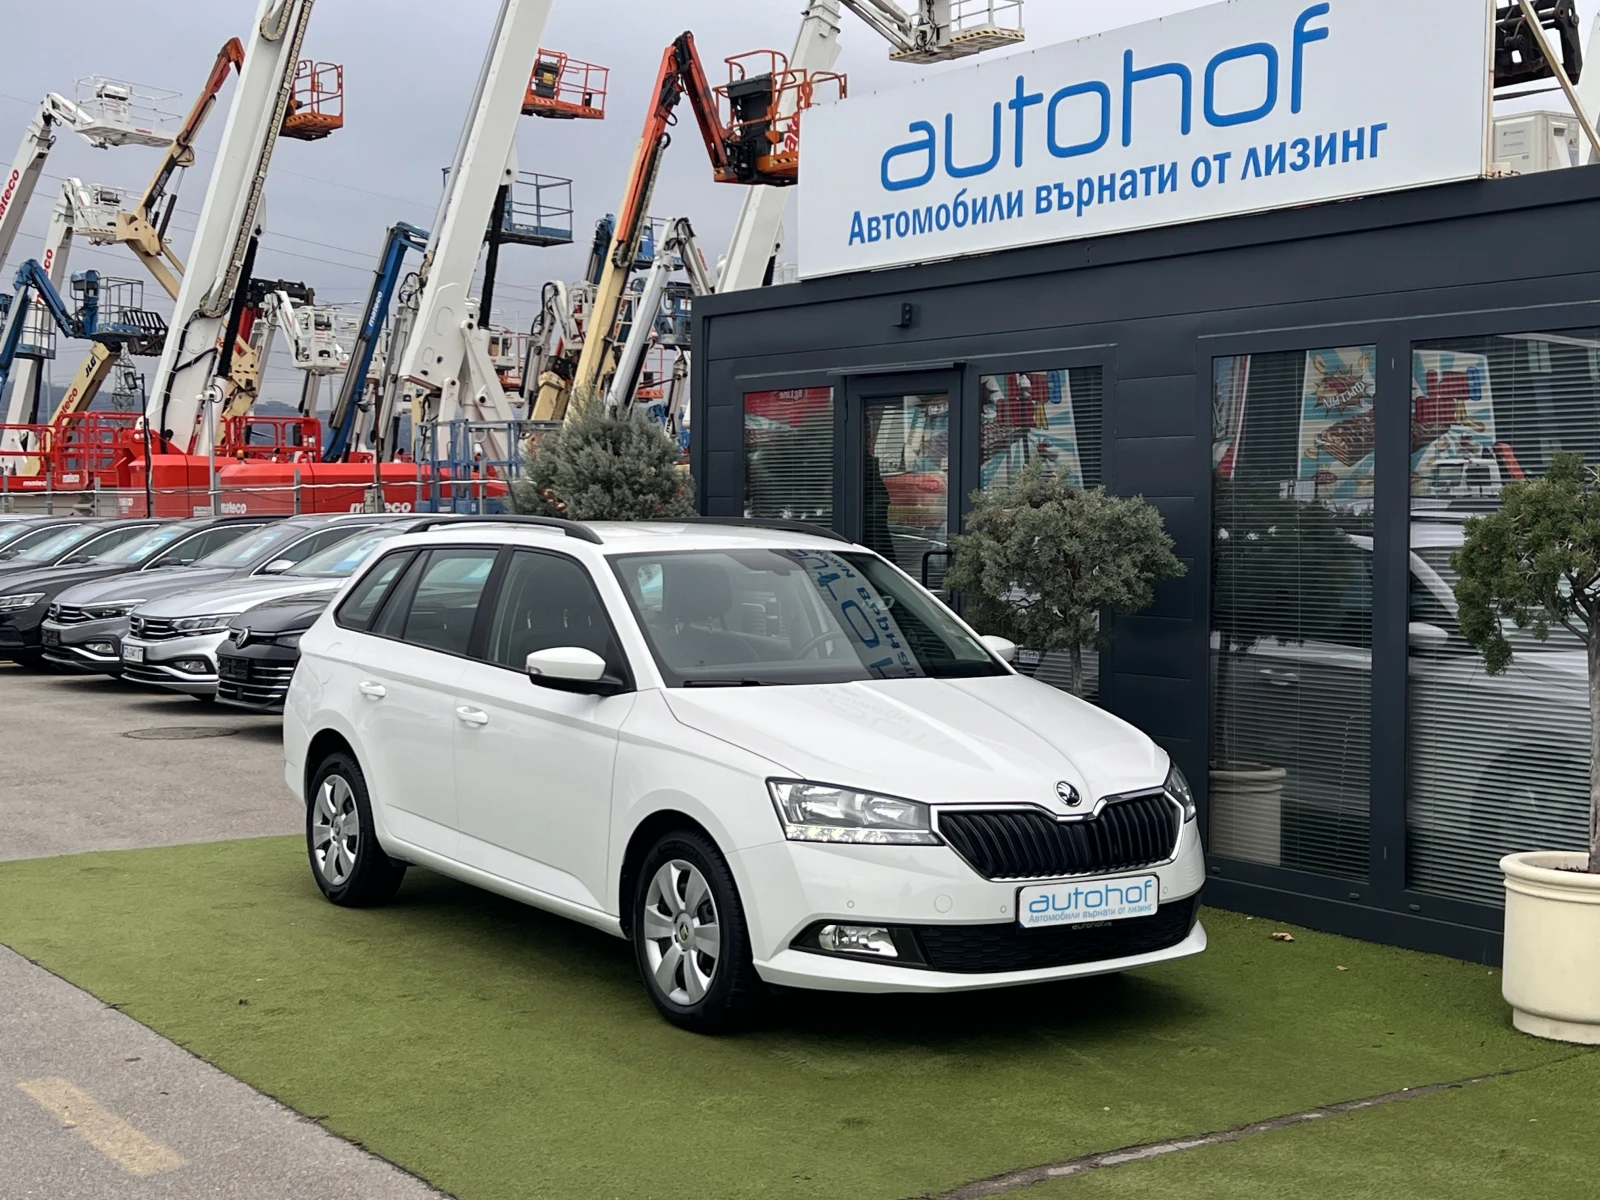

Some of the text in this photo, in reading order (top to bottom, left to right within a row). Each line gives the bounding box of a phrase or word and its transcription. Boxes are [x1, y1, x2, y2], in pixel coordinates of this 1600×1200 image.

[880, 2, 1331, 192] autohof
[0, 169, 19, 220] ateco
[848, 122, 1388, 246] Автомобили върнати от лизинг
[85, 356, 97, 378] JLG
[349, 502, 412, 514] meco
[1028, 879, 1152, 913] autohof
[1028, 903, 1153, 923] Автомобили върнати от лизинг
